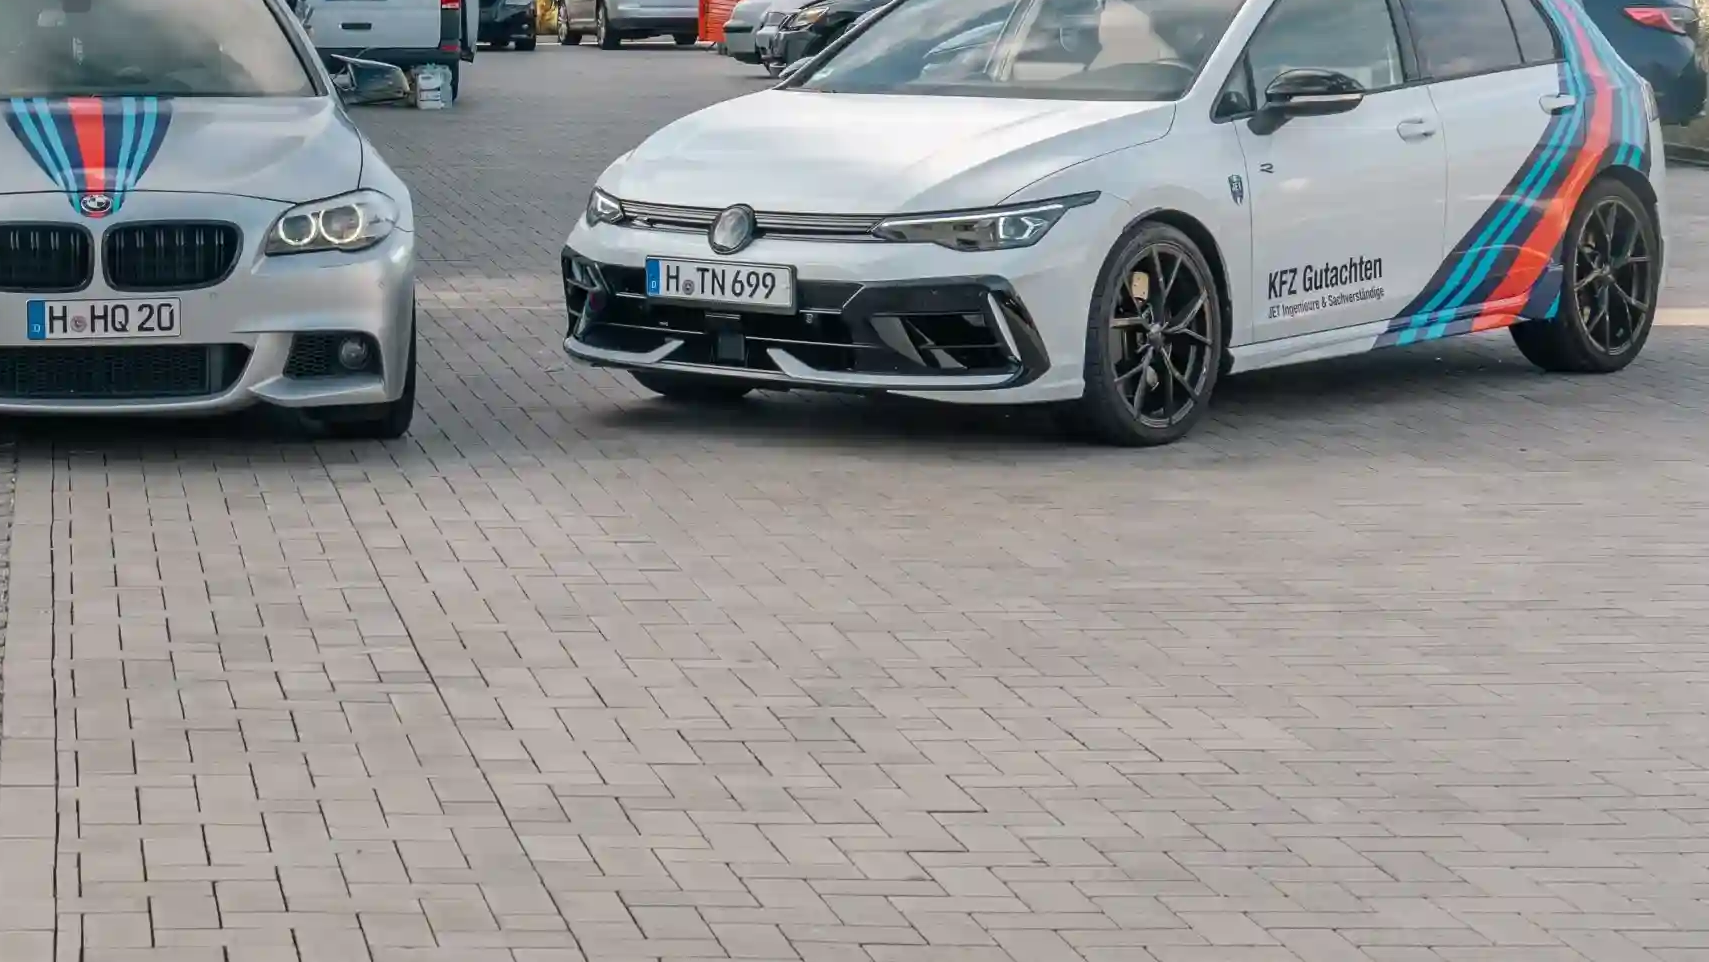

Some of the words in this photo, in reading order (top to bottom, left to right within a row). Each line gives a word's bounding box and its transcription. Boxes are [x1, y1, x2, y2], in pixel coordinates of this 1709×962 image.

[666, 265, 680, 292] H
[696, 267, 726, 296] TN
[731, 270, 776, 299] 699
[1268, 267, 1297, 300] KFZ
[1302, 255, 1383, 292] Gutachten
[49, 305, 68, 334] H
[90, 304, 130, 333] HQ
[137, 302, 175, 332] 20
[1268, 305, 1281, 319] JET
[1321, 296, 1327, 308] &
[1328, 285, 1385, 307] Sachverständige
